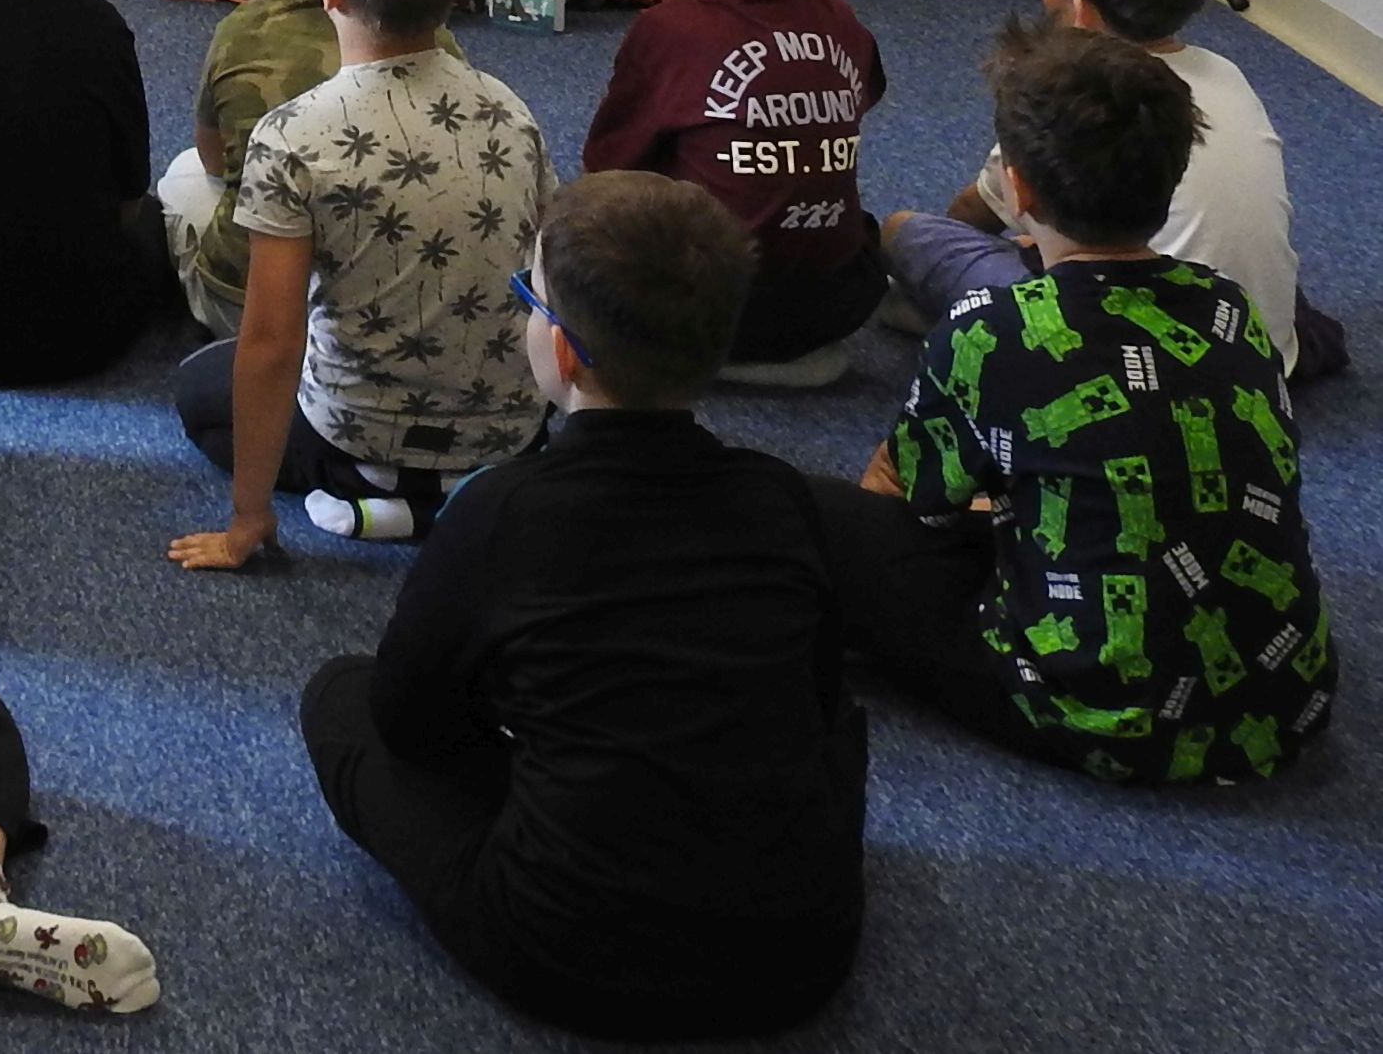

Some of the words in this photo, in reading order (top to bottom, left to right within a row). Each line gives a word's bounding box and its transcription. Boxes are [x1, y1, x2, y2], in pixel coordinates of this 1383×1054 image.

[703, 40, 768, 120] KEEP
[746, 89, 857, 129] AROUND
[1211, 298, 1232, 340] MODE
[1120, 345, 1147, 392] MODE
[999, 427, 1014, 475] MODE
[1171, 541, 1210, 591] MODE
